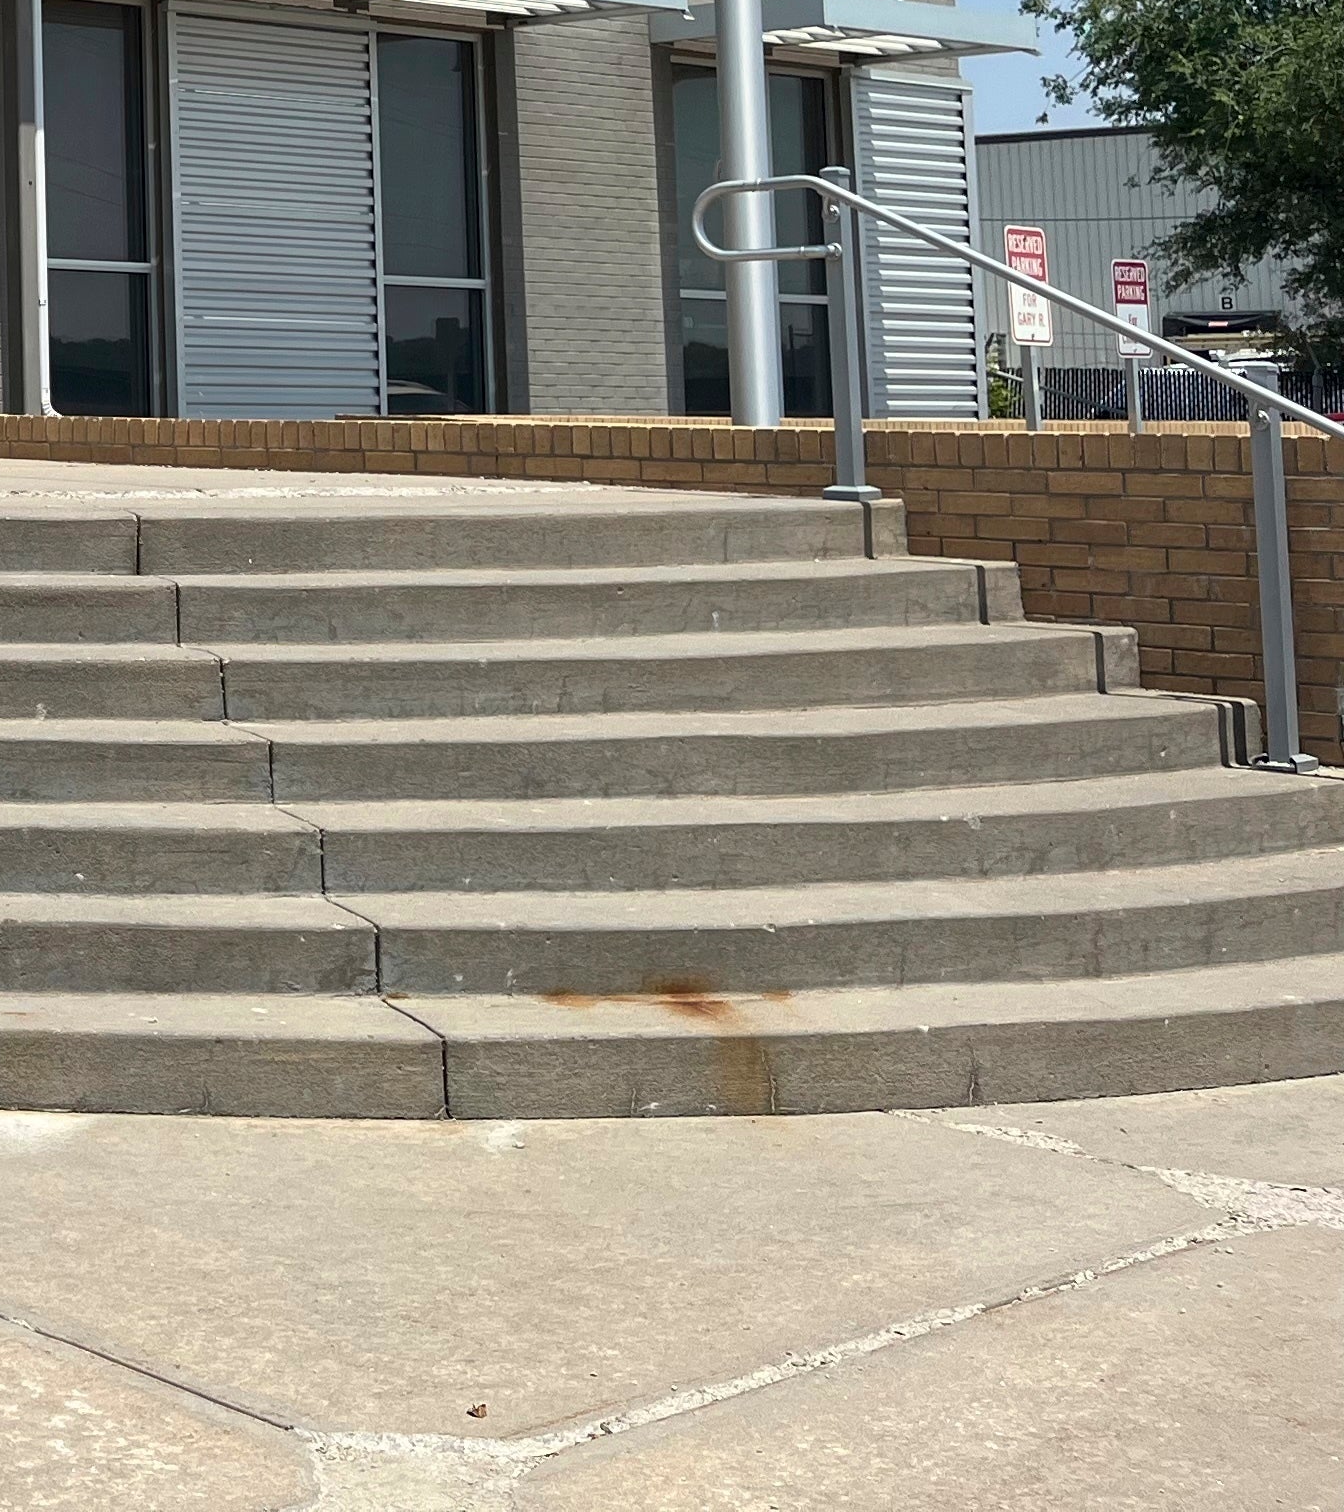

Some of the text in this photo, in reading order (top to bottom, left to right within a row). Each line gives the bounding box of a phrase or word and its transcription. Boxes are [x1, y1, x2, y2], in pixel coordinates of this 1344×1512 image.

[1008, 233, 1043, 255] RESERVED
[1011, 255, 1043, 277] PARKING
[1115, 266, 1145, 283] RESERVED
[1022, 292, 1037, 308] FOR
[1117, 284, 1145, 301] PARKING
[1221, 296, 1233, 310] B
[1017, 311, 1036, 326] GARY
